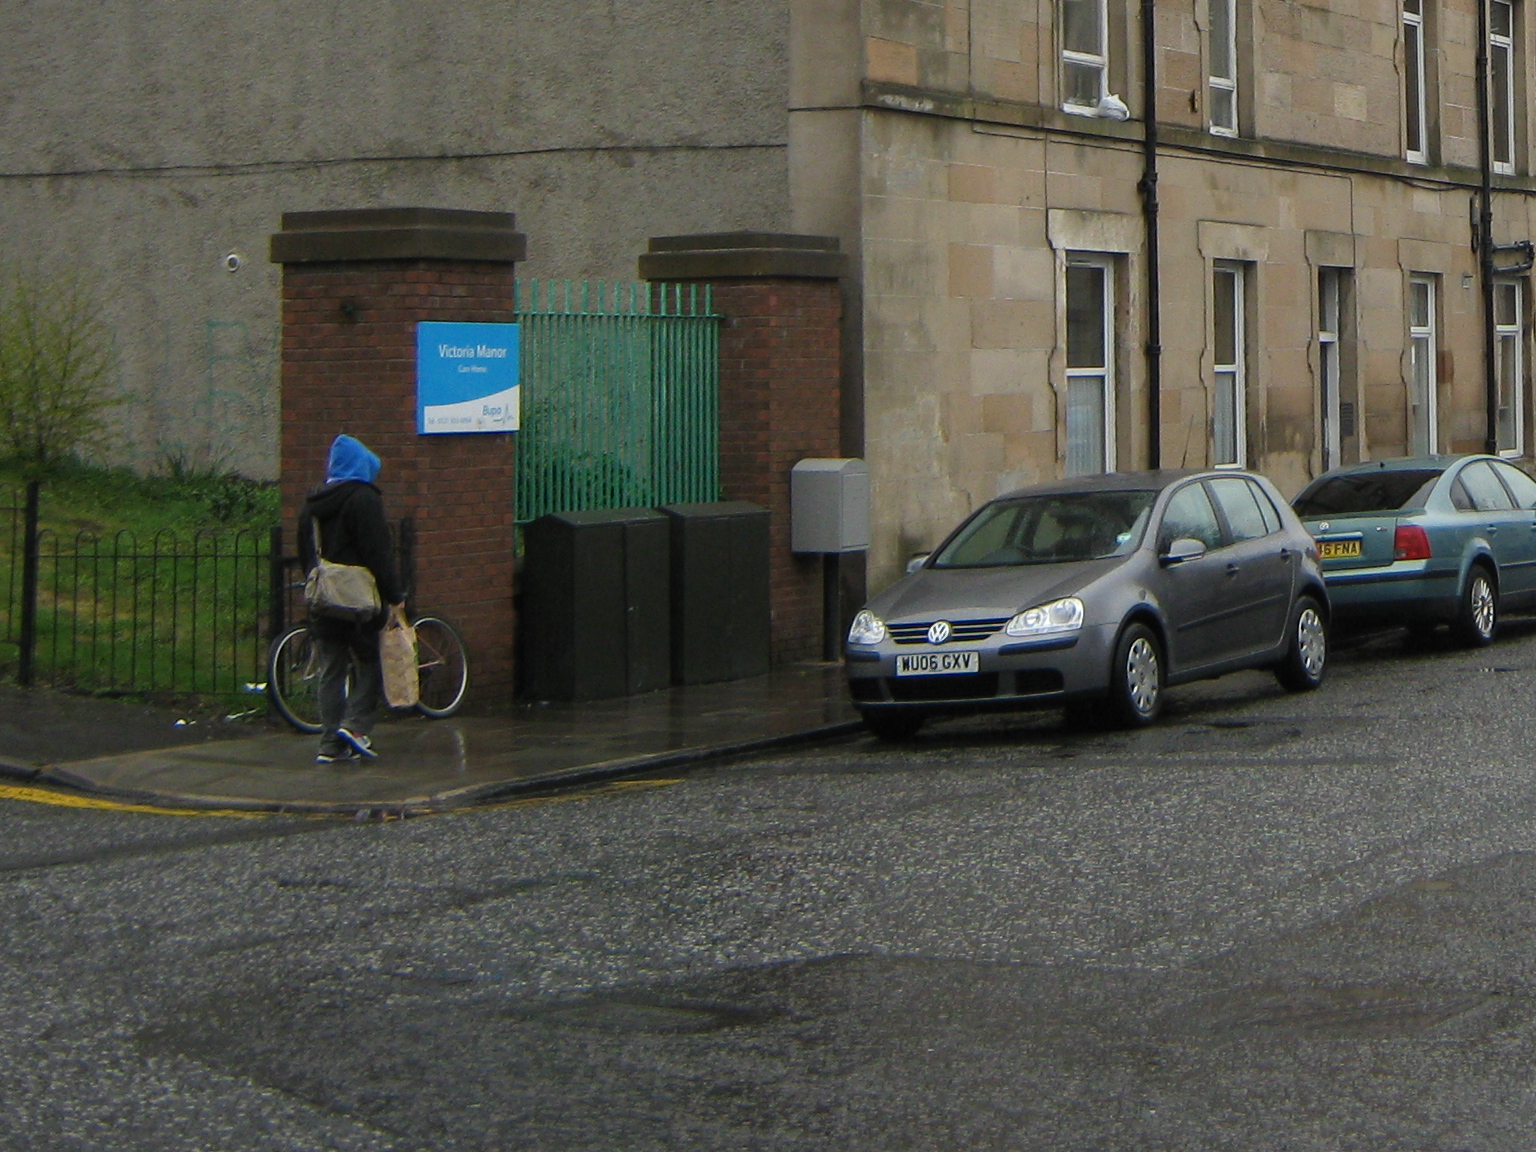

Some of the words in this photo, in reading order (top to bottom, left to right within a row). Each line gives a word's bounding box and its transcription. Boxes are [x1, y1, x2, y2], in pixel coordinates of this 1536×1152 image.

[438, 344, 475, 358] Victoria
[477, 344, 508, 358] Manor
[482, 405, 502, 417] Bupa
[1334, 542, 1358, 555] FNA
[902, 655, 938, 671] WU06
[942, 653, 971, 670] GXV
